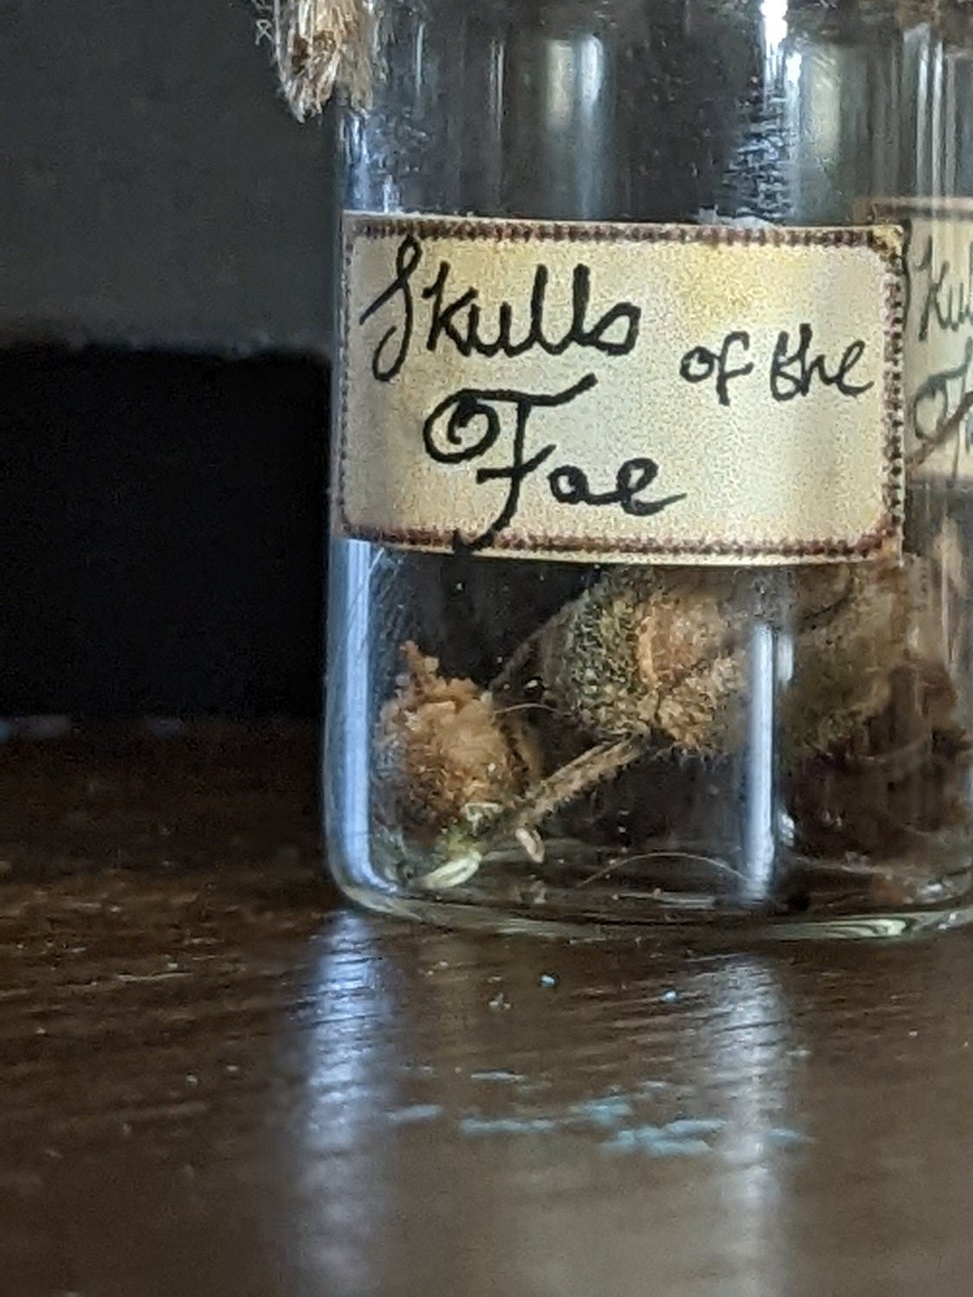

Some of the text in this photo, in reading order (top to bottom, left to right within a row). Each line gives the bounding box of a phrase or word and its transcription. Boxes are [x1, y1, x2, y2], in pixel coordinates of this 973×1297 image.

[359, 234, 876, 407] Skulls of the
[422, 372, 688, 560] Fae
